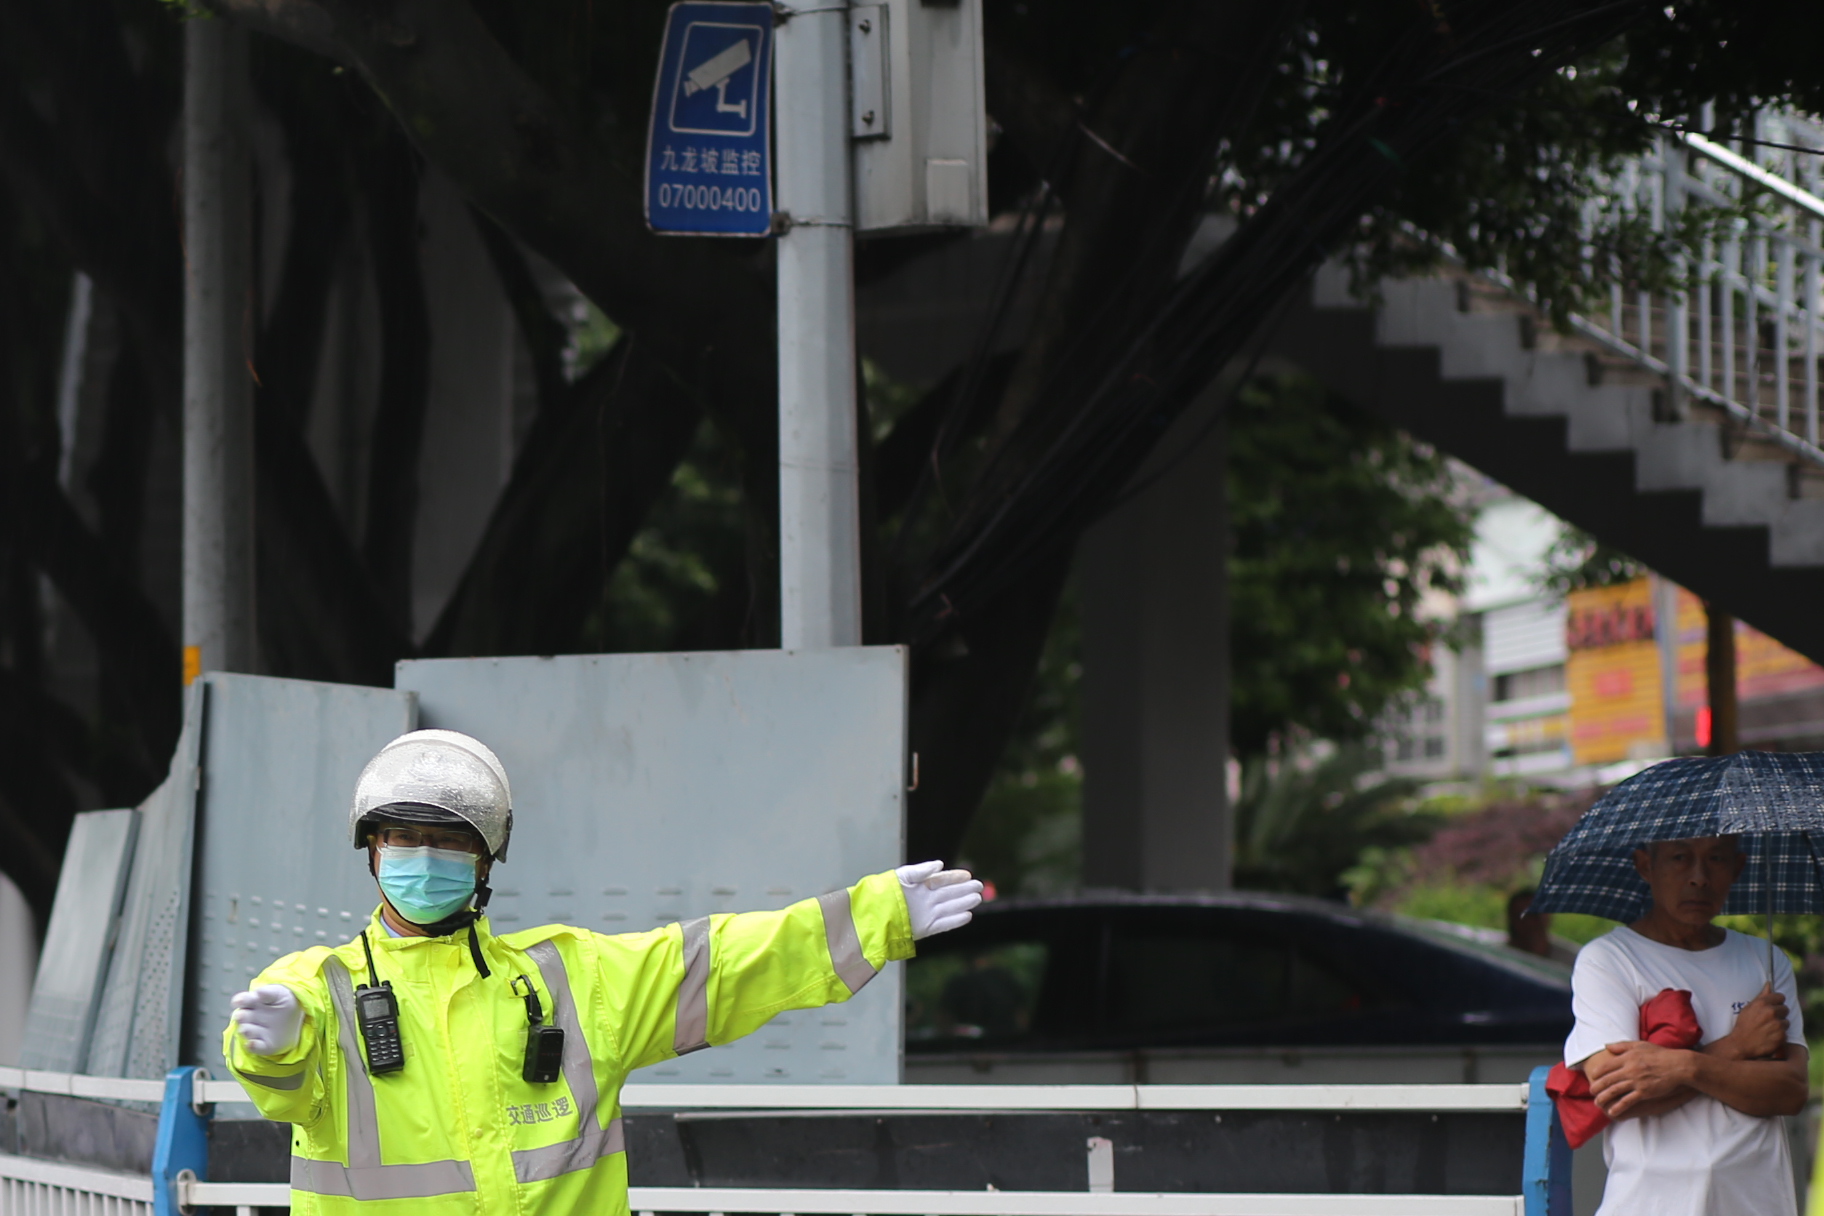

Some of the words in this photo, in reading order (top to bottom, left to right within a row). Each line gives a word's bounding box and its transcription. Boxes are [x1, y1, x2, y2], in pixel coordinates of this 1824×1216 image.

[660, 145, 762, 176] 九龙坡监控
[658, 183, 762, 213] 07000400
[506, 1096, 573, 1126] 交通巡逻
